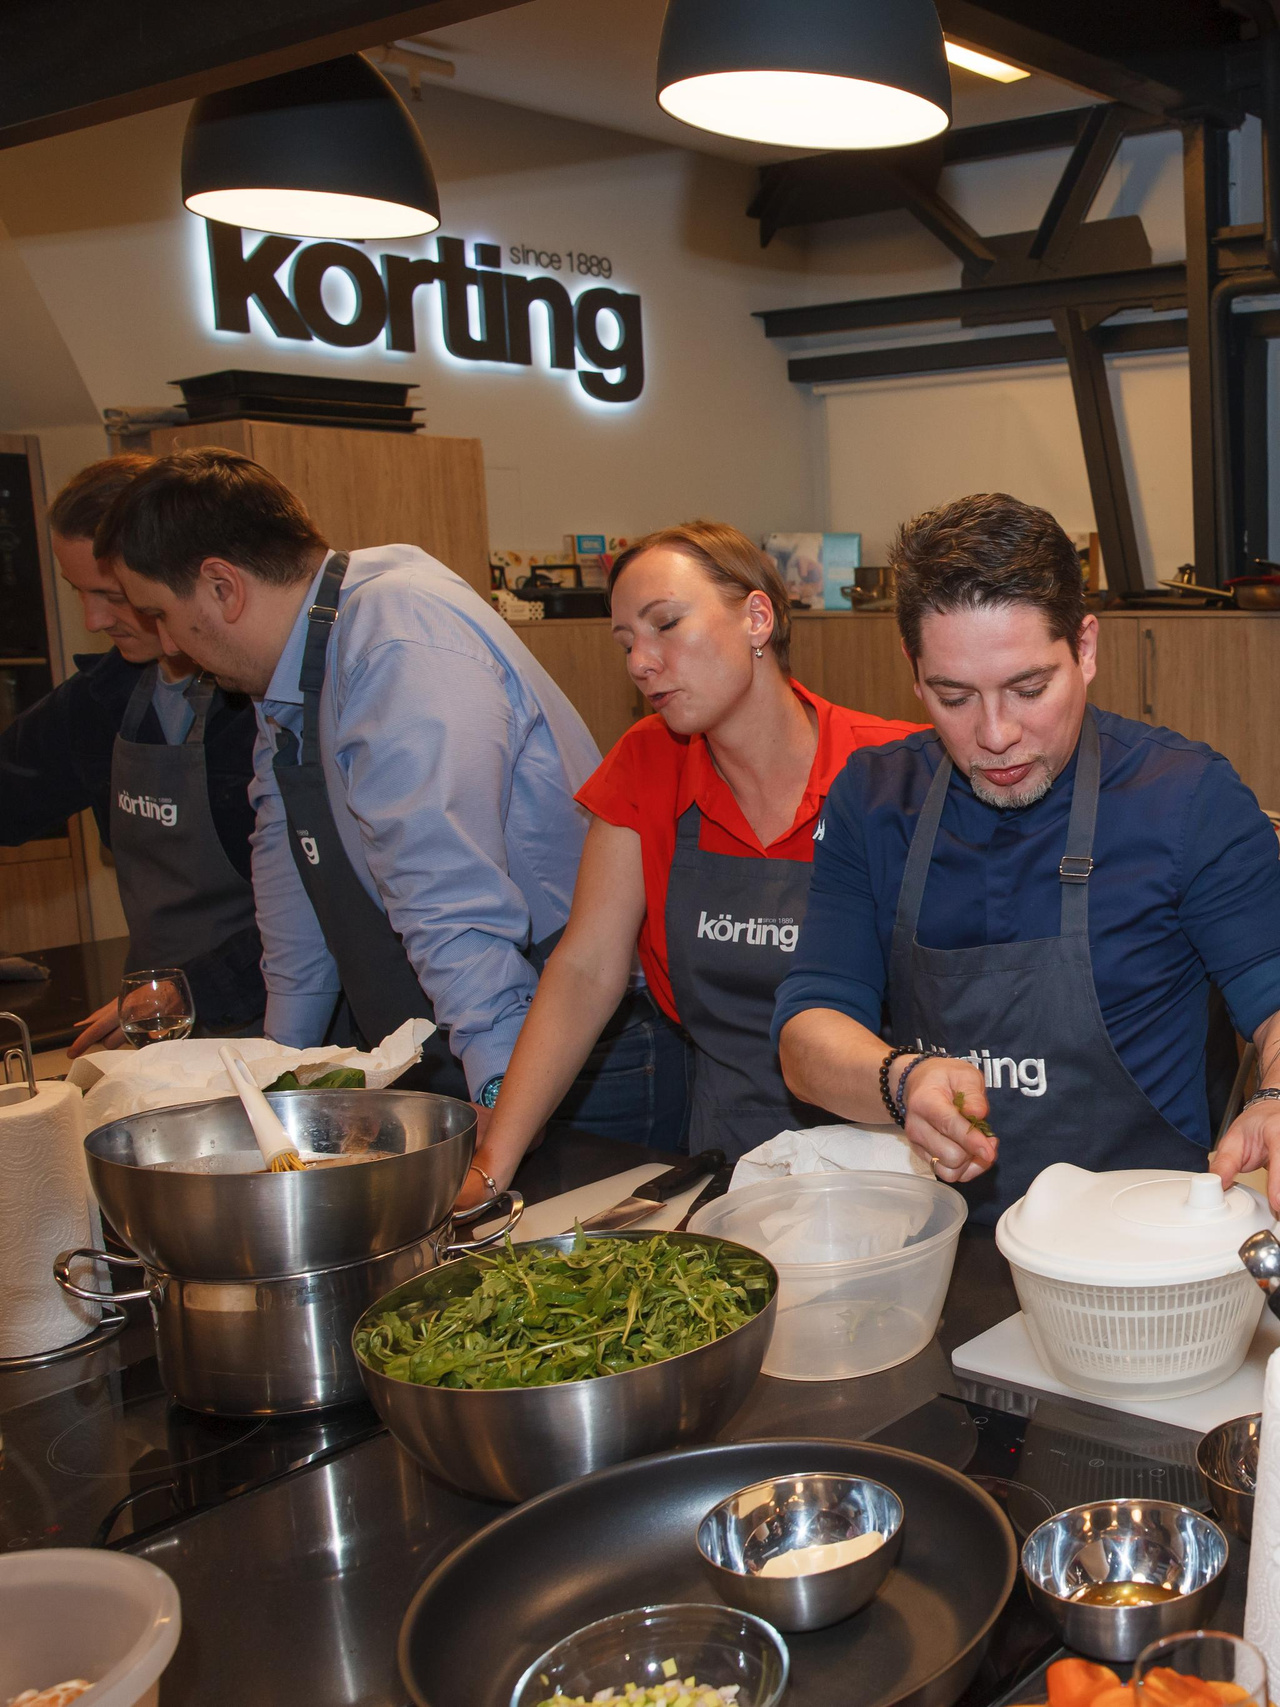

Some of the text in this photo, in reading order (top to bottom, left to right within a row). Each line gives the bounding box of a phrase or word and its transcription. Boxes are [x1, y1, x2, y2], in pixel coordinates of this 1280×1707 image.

[509, 243, 612, 279] since 1889
[117, 789, 178, 827] körting
[697, 911, 799, 952] körting
